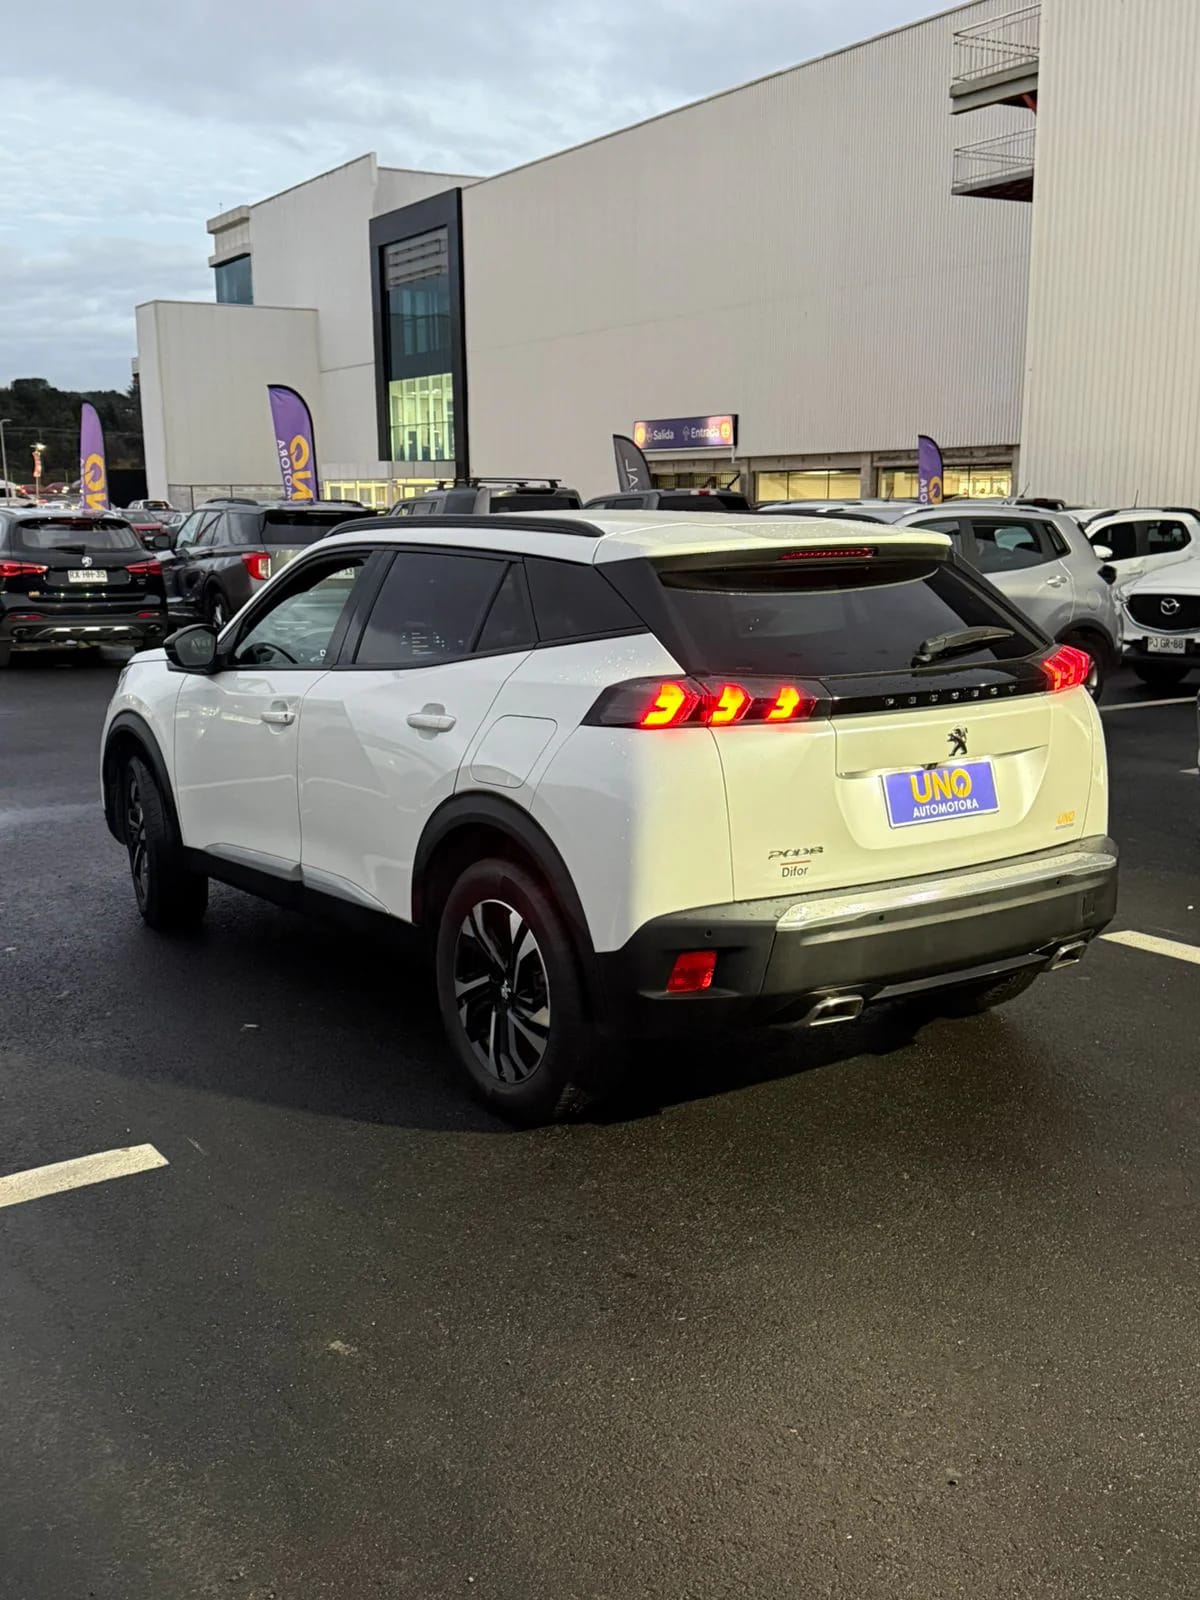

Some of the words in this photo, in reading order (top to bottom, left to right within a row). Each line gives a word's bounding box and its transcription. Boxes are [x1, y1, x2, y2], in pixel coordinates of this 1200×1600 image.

[653, 428, 675, 441] Salida
[690, 425, 720, 439] Entrada
[910, 768, 972, 804] UNO
[912, 798, 980, 818] AUTOMOTORA
[781, 866, 809, 878] Difor
